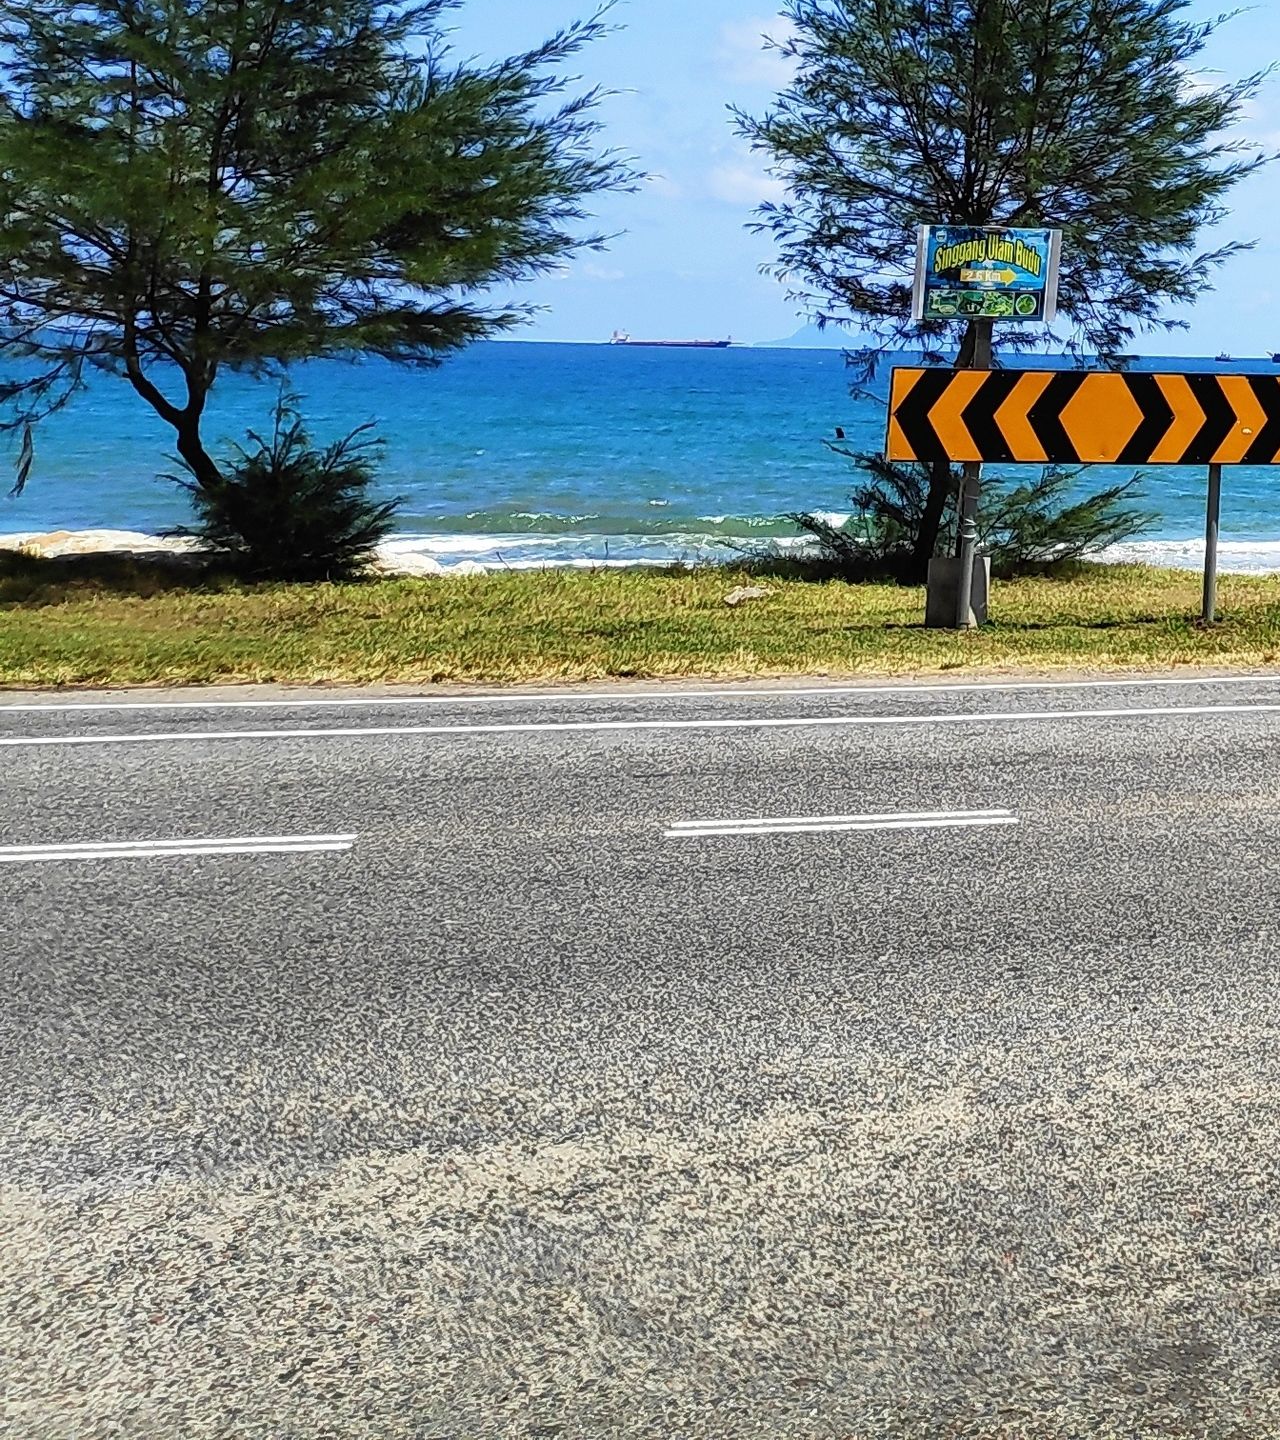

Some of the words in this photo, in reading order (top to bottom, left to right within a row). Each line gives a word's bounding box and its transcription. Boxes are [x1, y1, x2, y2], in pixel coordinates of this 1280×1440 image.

[934, 239, 986, 273] Singgang
[988, 233, 1014, 261] Ulam
[1015, 239, 1041, 276] Budu
